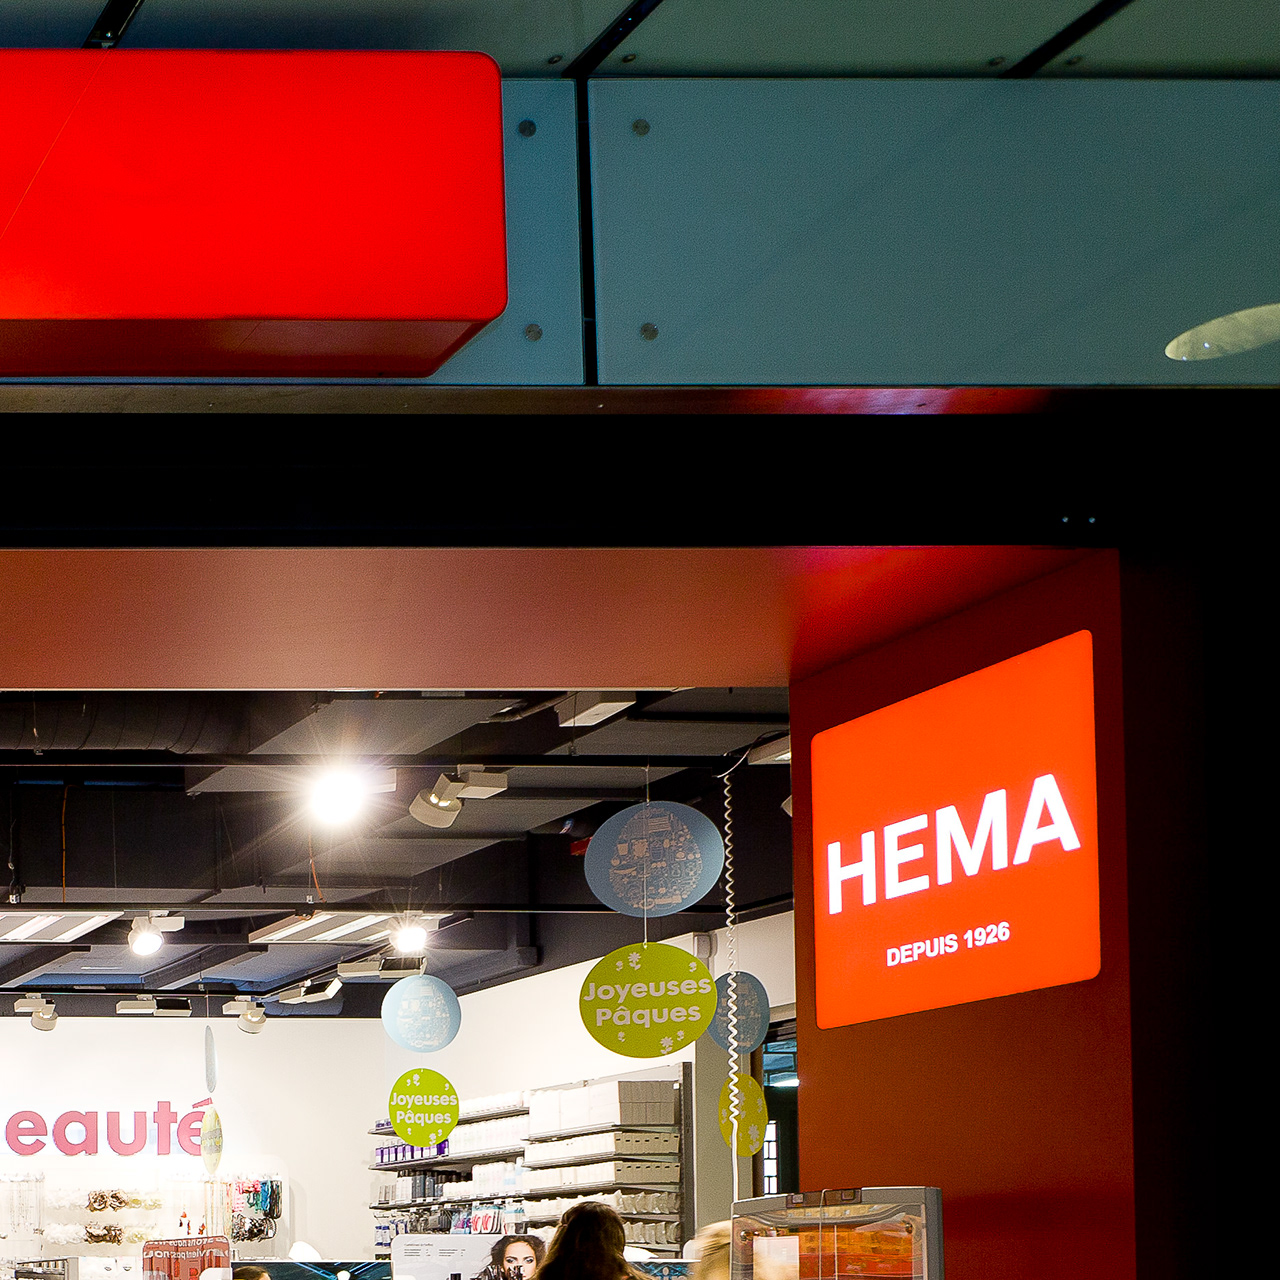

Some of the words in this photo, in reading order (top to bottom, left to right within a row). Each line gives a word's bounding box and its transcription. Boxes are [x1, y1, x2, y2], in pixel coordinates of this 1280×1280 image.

[827, 773, 1081, 915] HEMA
[886, 933, 958, 967] DEPUIS
[963, 921, 1010, 949] 1926
[583, 977, 712, 1004] Joyeuses
[595, 1005, 702, 1028] Pâques
[391, 1092, 458, 1109] Joyeuses
[396, 1109, 452, 1126] Pâques
